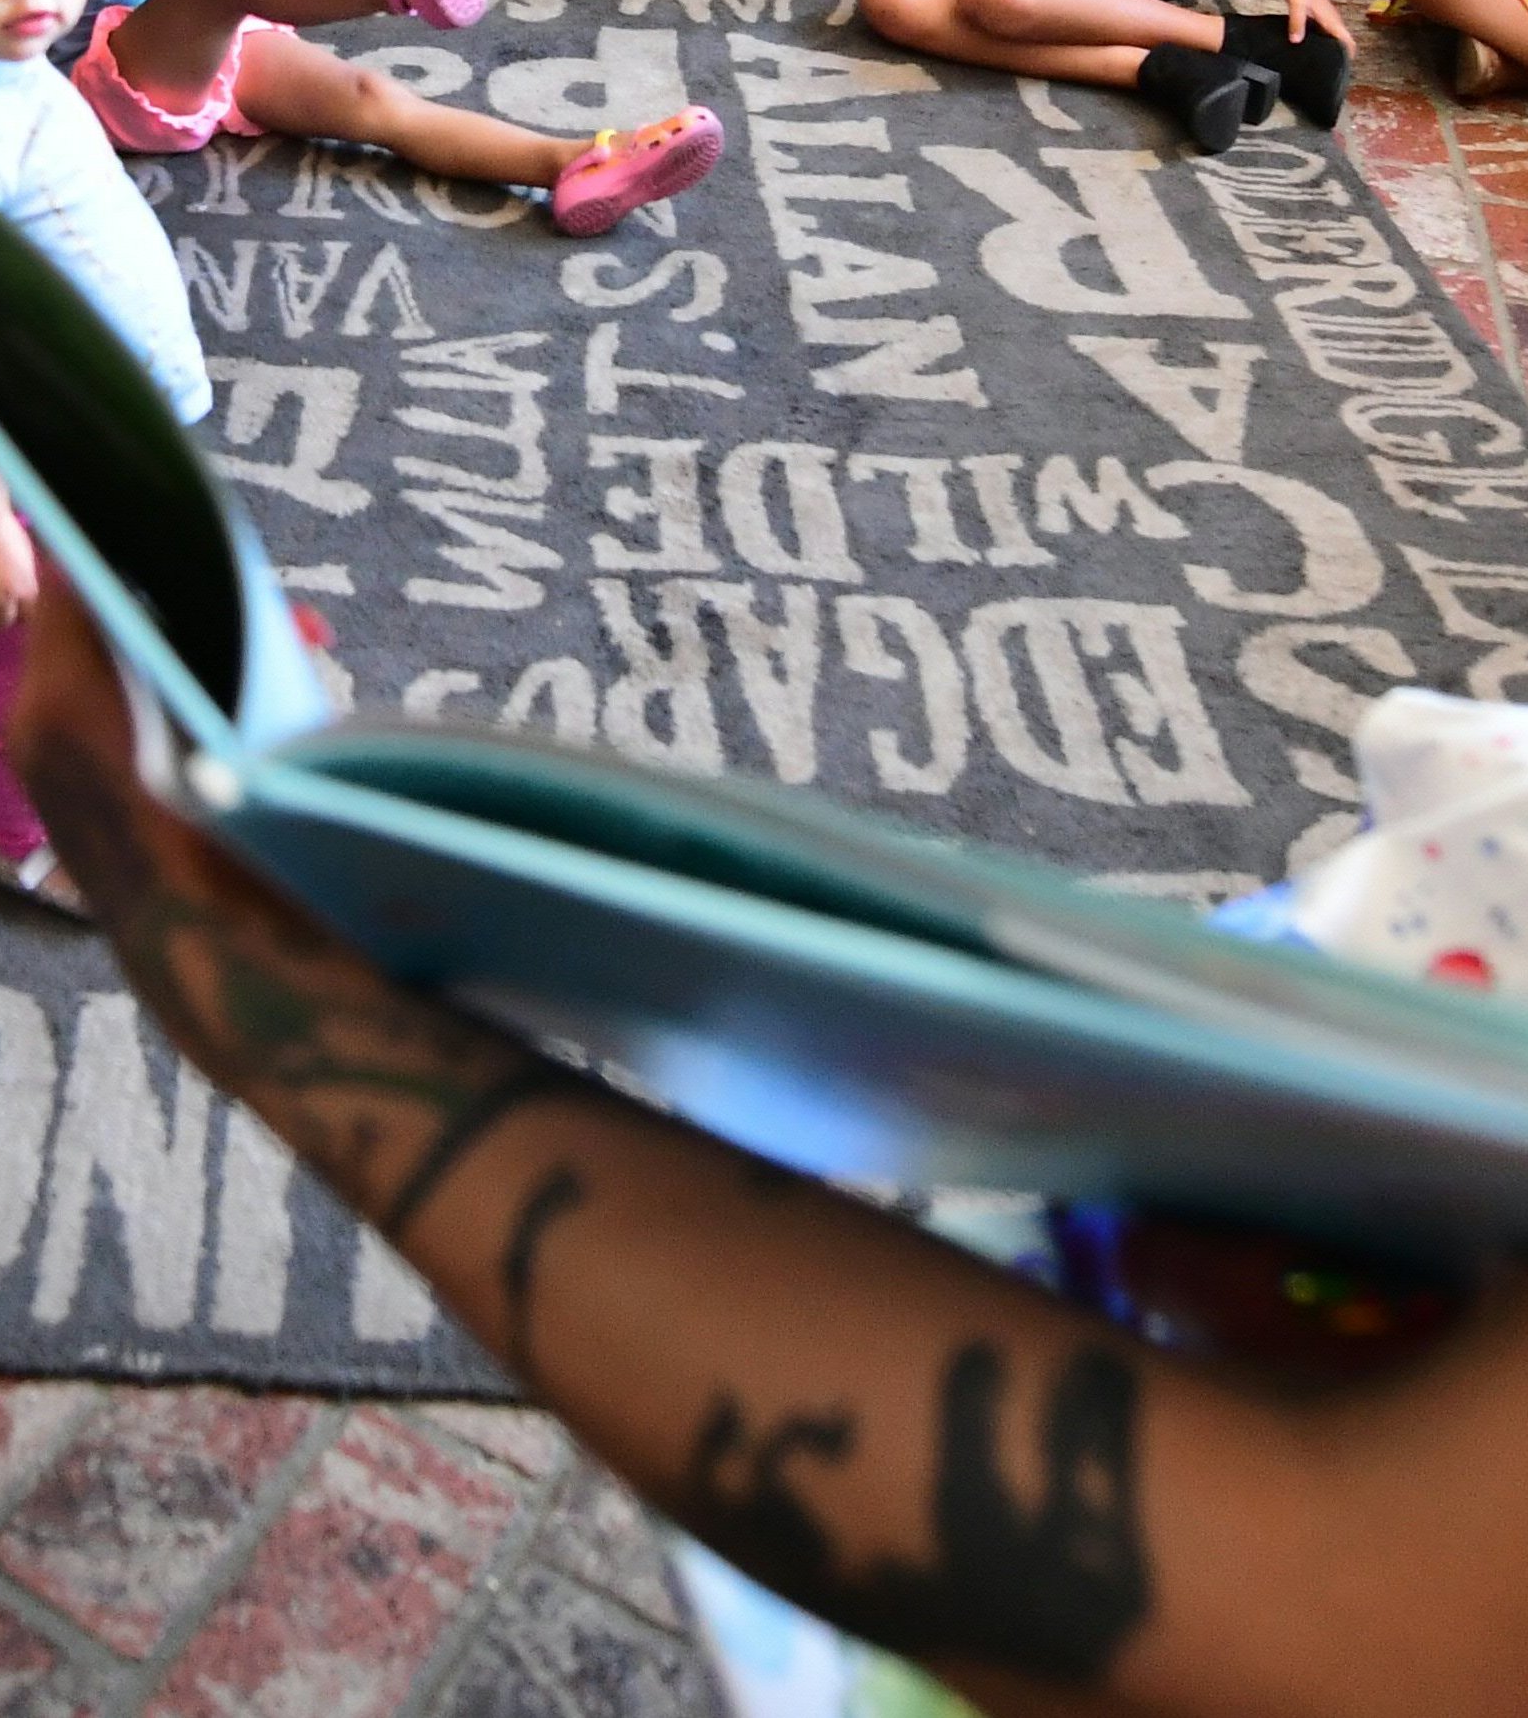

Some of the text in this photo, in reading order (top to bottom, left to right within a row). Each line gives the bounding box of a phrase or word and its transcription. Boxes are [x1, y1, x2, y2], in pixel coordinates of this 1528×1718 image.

[726, 32, 989, 409] ALLAN
[588, 436, 1189, 584] WILDE
[589, 578, 1257, 808] EDGAR
